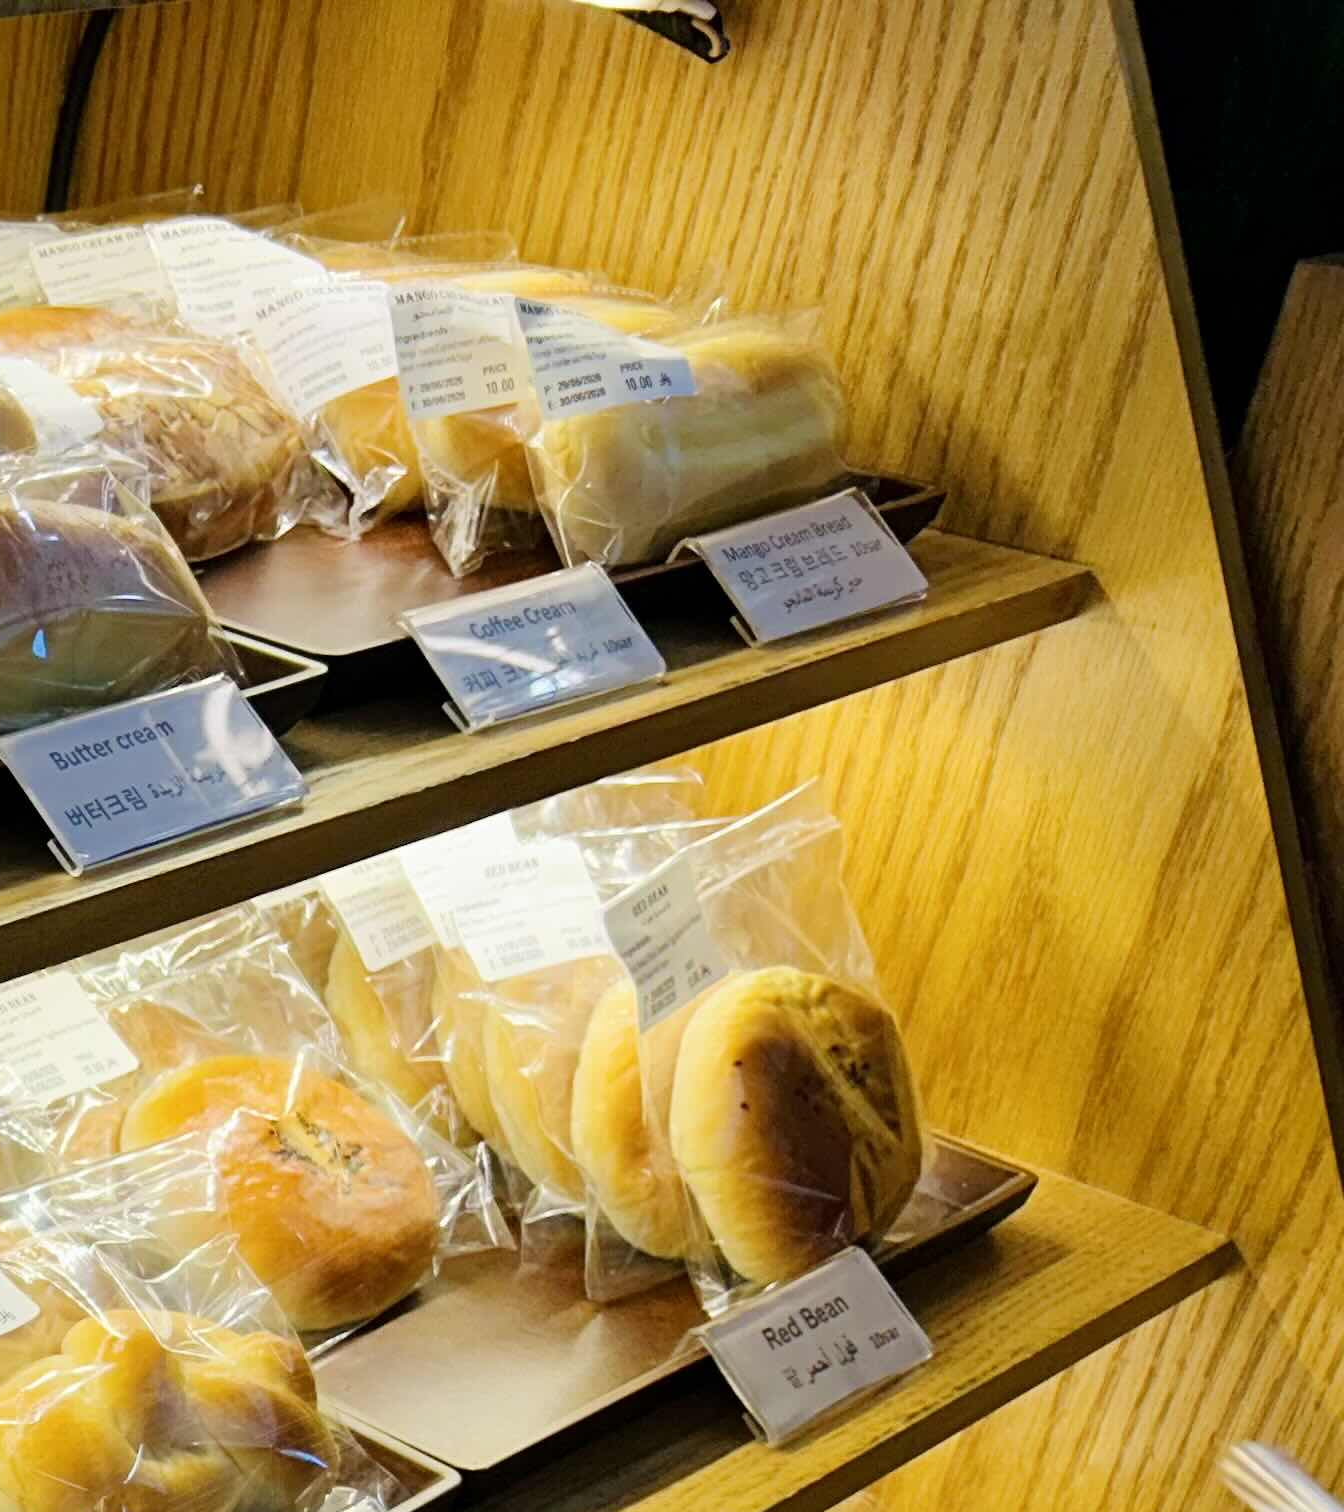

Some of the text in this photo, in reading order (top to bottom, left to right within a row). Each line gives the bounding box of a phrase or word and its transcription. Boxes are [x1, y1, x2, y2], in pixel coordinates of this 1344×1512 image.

[722, 515, 852, 563] Mango Cream Bread
[469, 600, 577, 640] Coffee Cream
[463, 669, 502, 692] 커피
[49, 718, 175, 772] Butter cream
[64, 785, 148, 829] 버터크림
[762, 1296, 849, 1350] Red Bean
